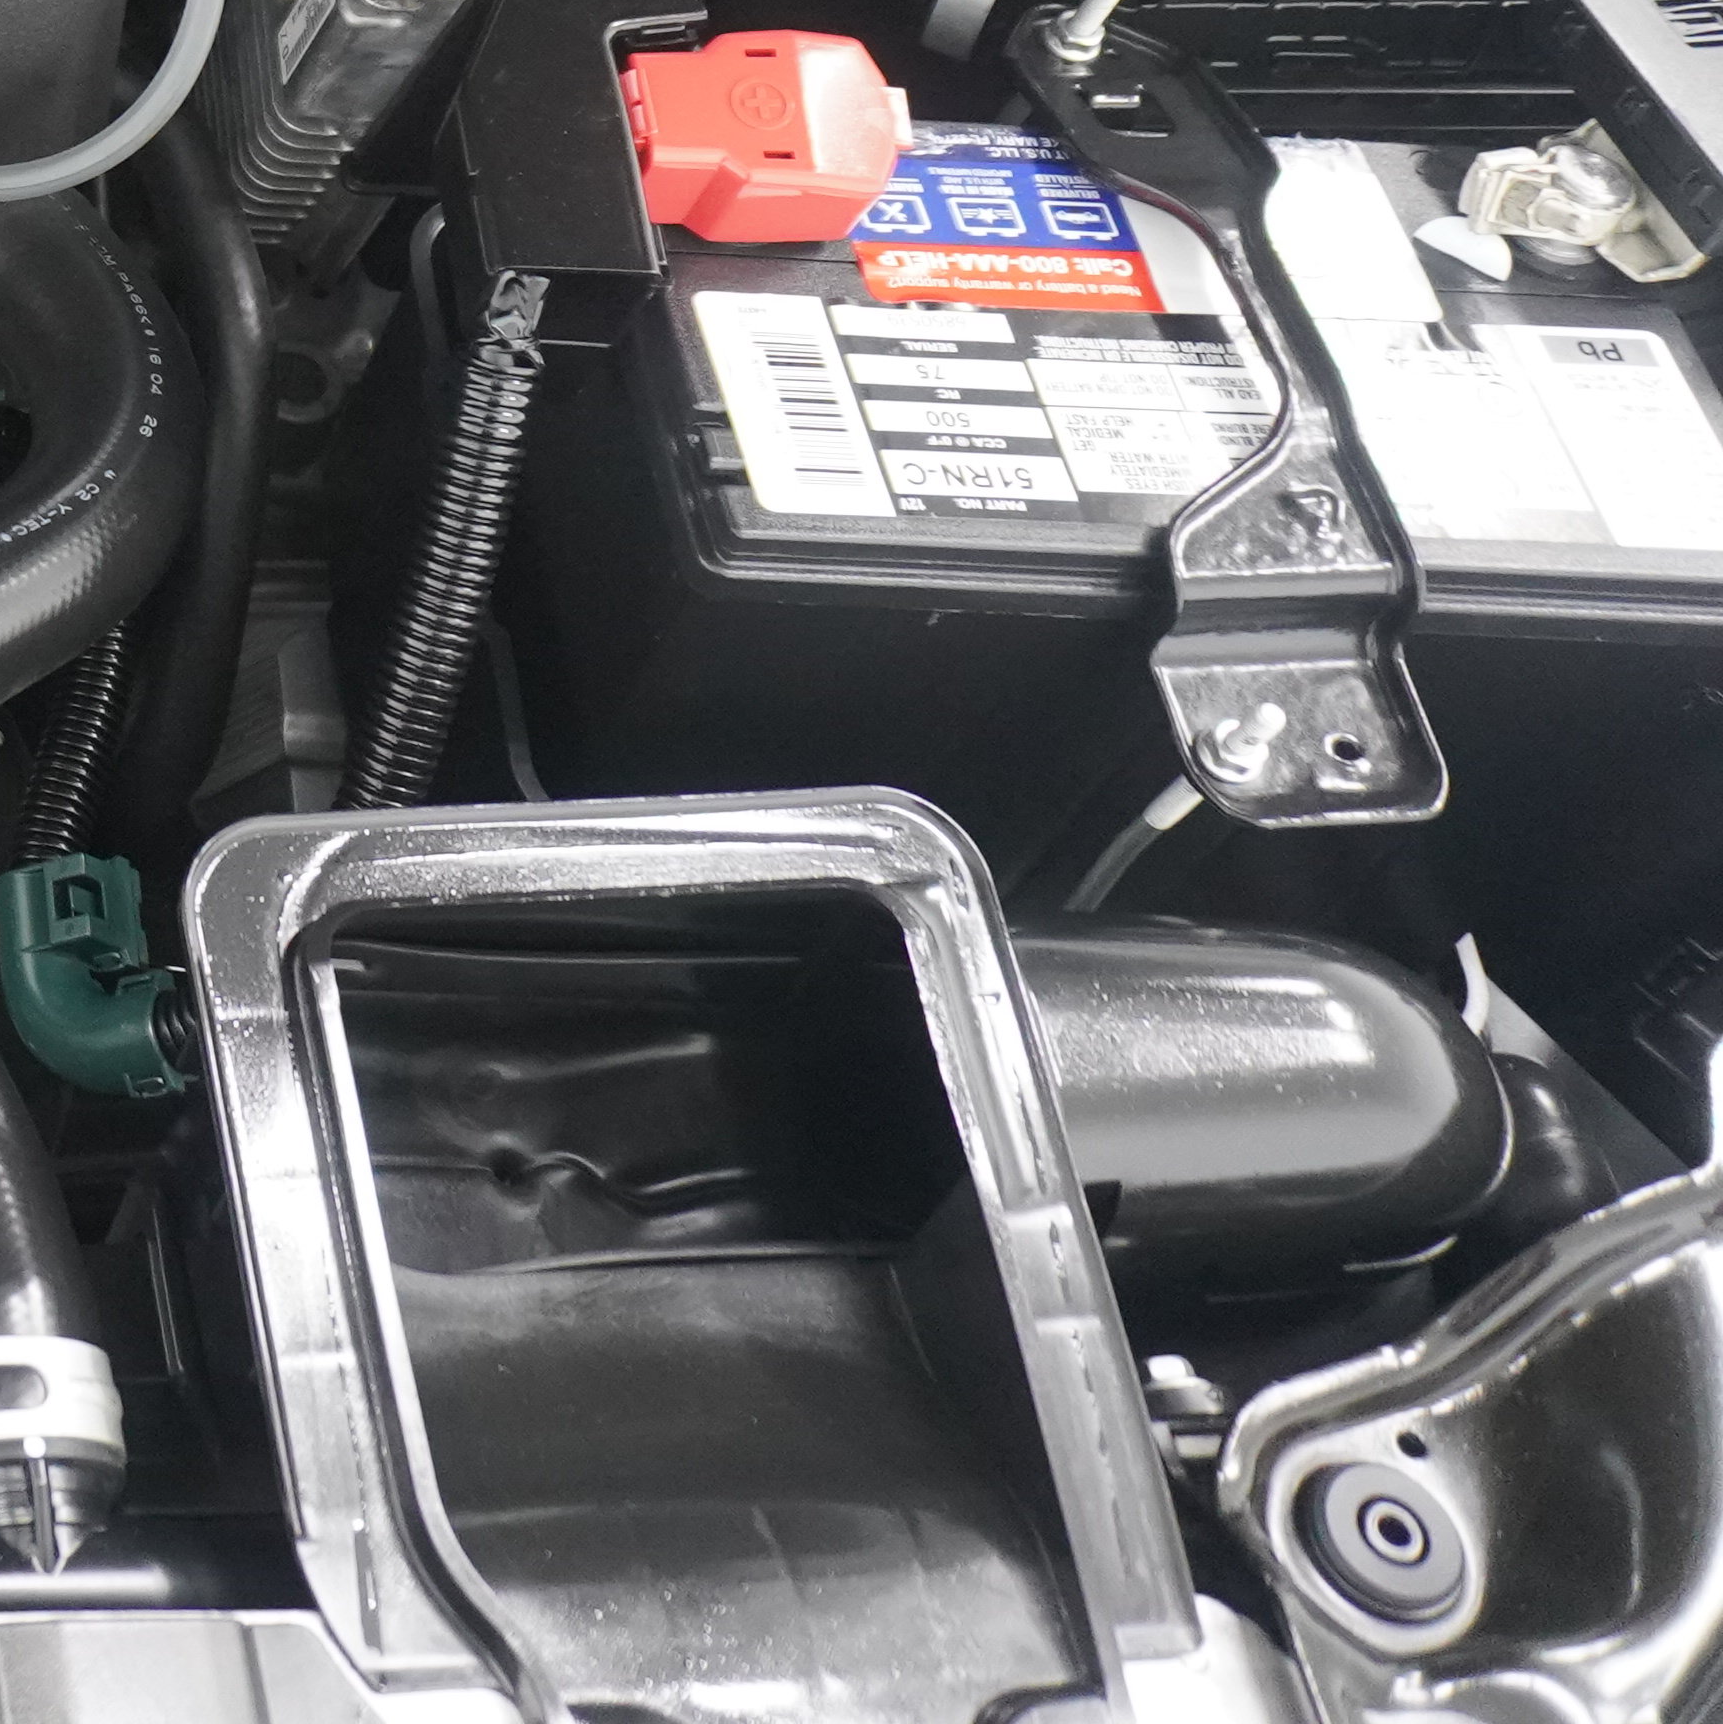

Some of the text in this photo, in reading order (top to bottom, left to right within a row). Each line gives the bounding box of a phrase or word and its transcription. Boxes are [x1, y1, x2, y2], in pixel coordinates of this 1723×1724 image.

[877, 250, 1133, 276] Call: 800-AAA-HELP
[886, 276, 950, 289] support?
[952, 277, 1016, 291] warranty
[1035, 279, 1086, 295] battery
[1103, 284, 1141, 297] Need
[902, 341, 957, 352] SERIAL
[1577, 340, 1625, 362] Pb
[1200, 352, 1225, 365] NOT
[916, 364, 943, 380] 75
[934, 388, 961, 399] RC
[138, 414, 158, 438] 26
[926, 411, 970, 428] 500
[972, 437, 1007, 448] CCA
[1073, 440, 1095, 451] GET
[903, 462, 1032, 490] 51RN-C
[1125, 478, 1157, 490] EYES
[899, 497, 925, 510] 12V
[984, 499, 1027, 511] PART
